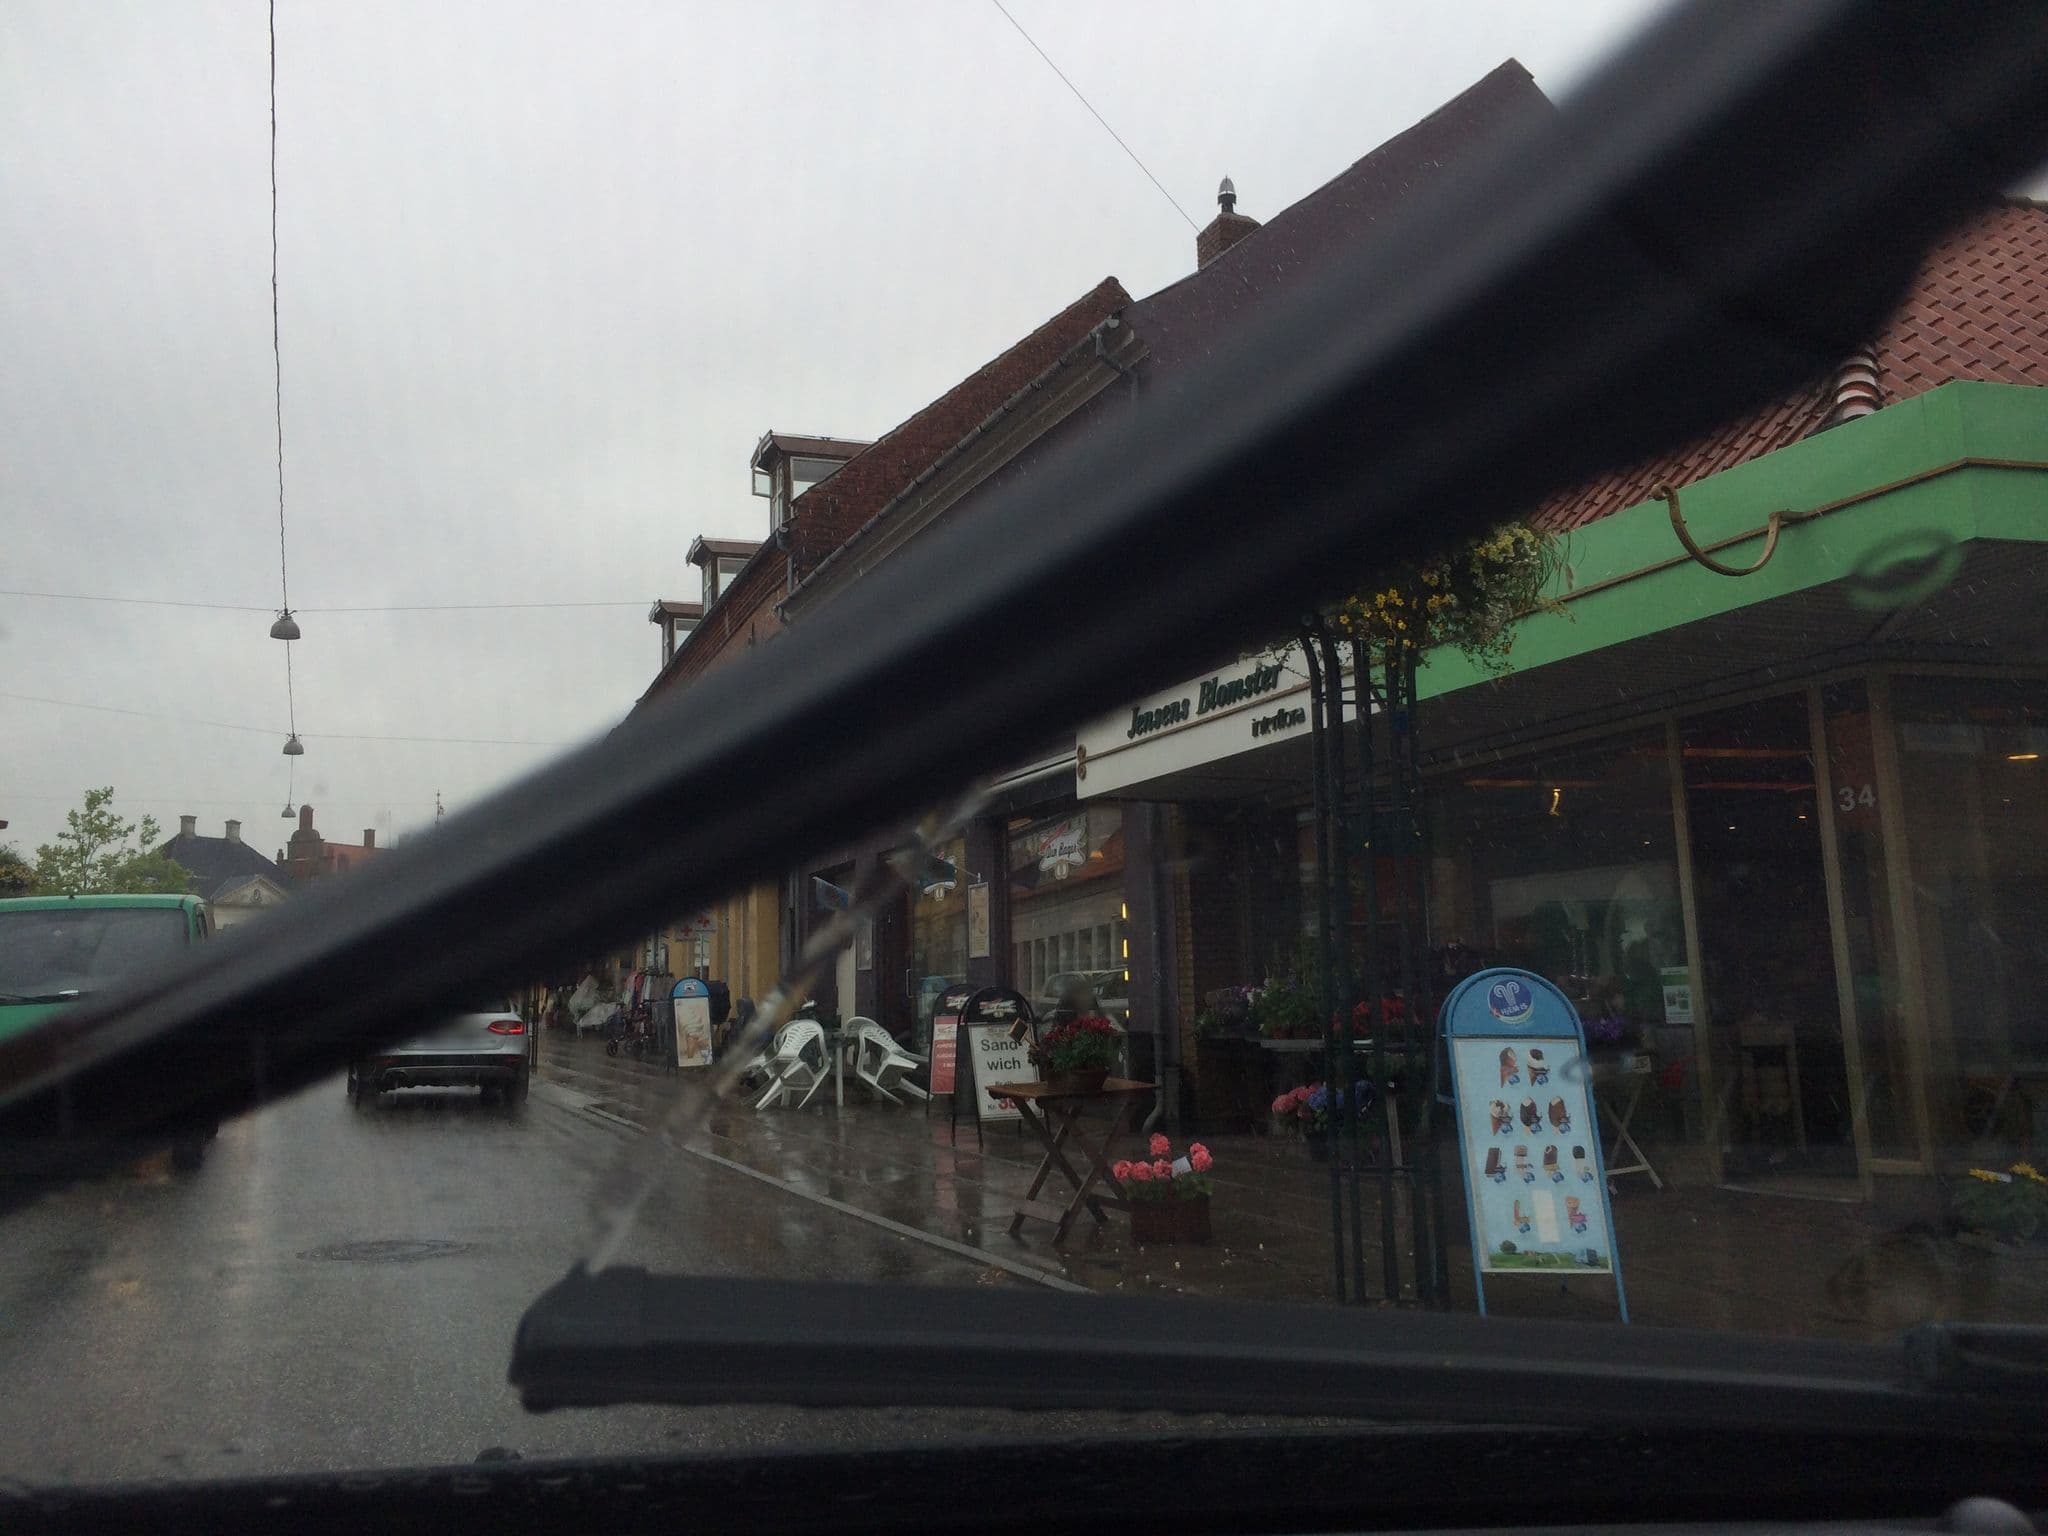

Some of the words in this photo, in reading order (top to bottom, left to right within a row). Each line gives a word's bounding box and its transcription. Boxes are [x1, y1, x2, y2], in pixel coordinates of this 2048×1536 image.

[1127, 698, 1190, 739] Jensens
[1196, 663, 1283, 715] Blomster
[1839, 784, 1873, 811] 34
[986, 1057, 1021, 1071] wich
